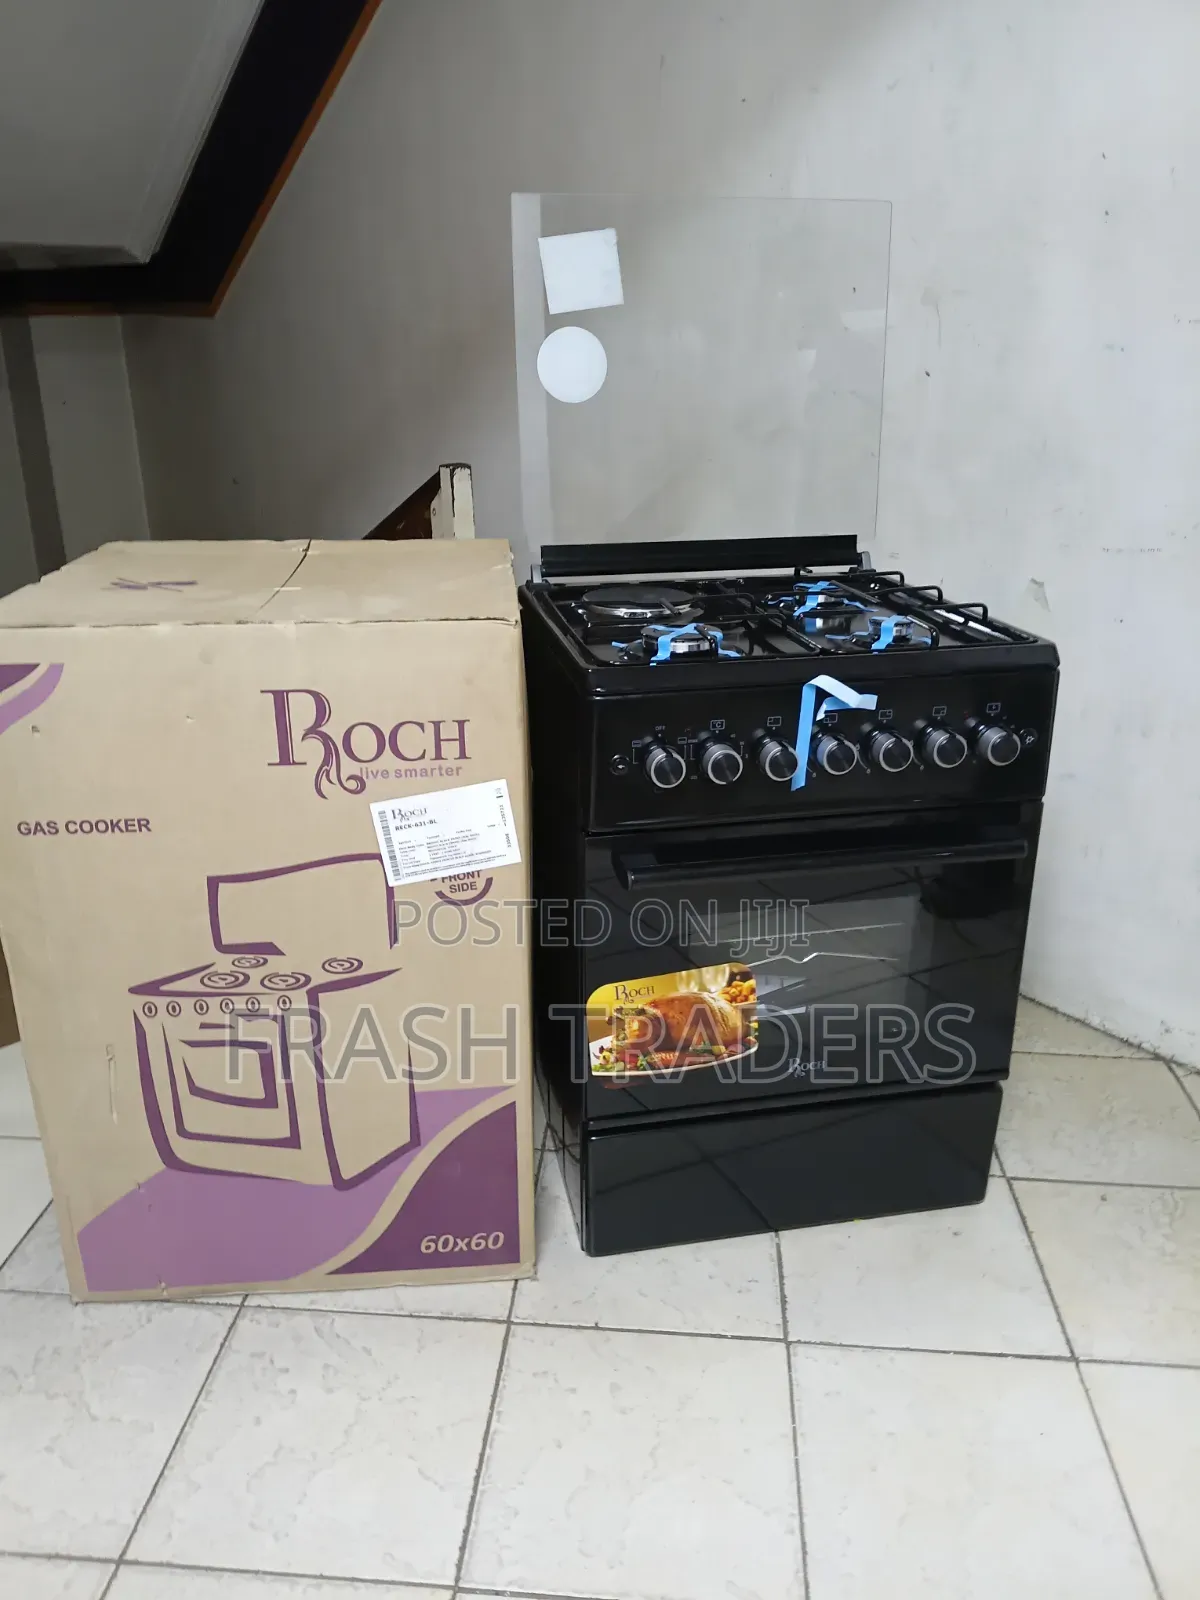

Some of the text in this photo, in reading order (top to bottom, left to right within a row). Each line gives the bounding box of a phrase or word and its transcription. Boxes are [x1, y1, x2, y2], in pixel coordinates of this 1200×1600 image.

[260, 689, 472, 799] ROCH
[360, 764, 463, 780] live smarter
[391, 807, 428, 823] ROCH
[17, 817, 152, 836] GAS COOKER
[441, 869, 482, 884] FRONT
[449, 881, 478, 894] SIDE
[614, 984, 655, 1004] ROCH
[788, 1057, 826, 1077] ROCH
[420, 1231, 505, 1254] 60x60
